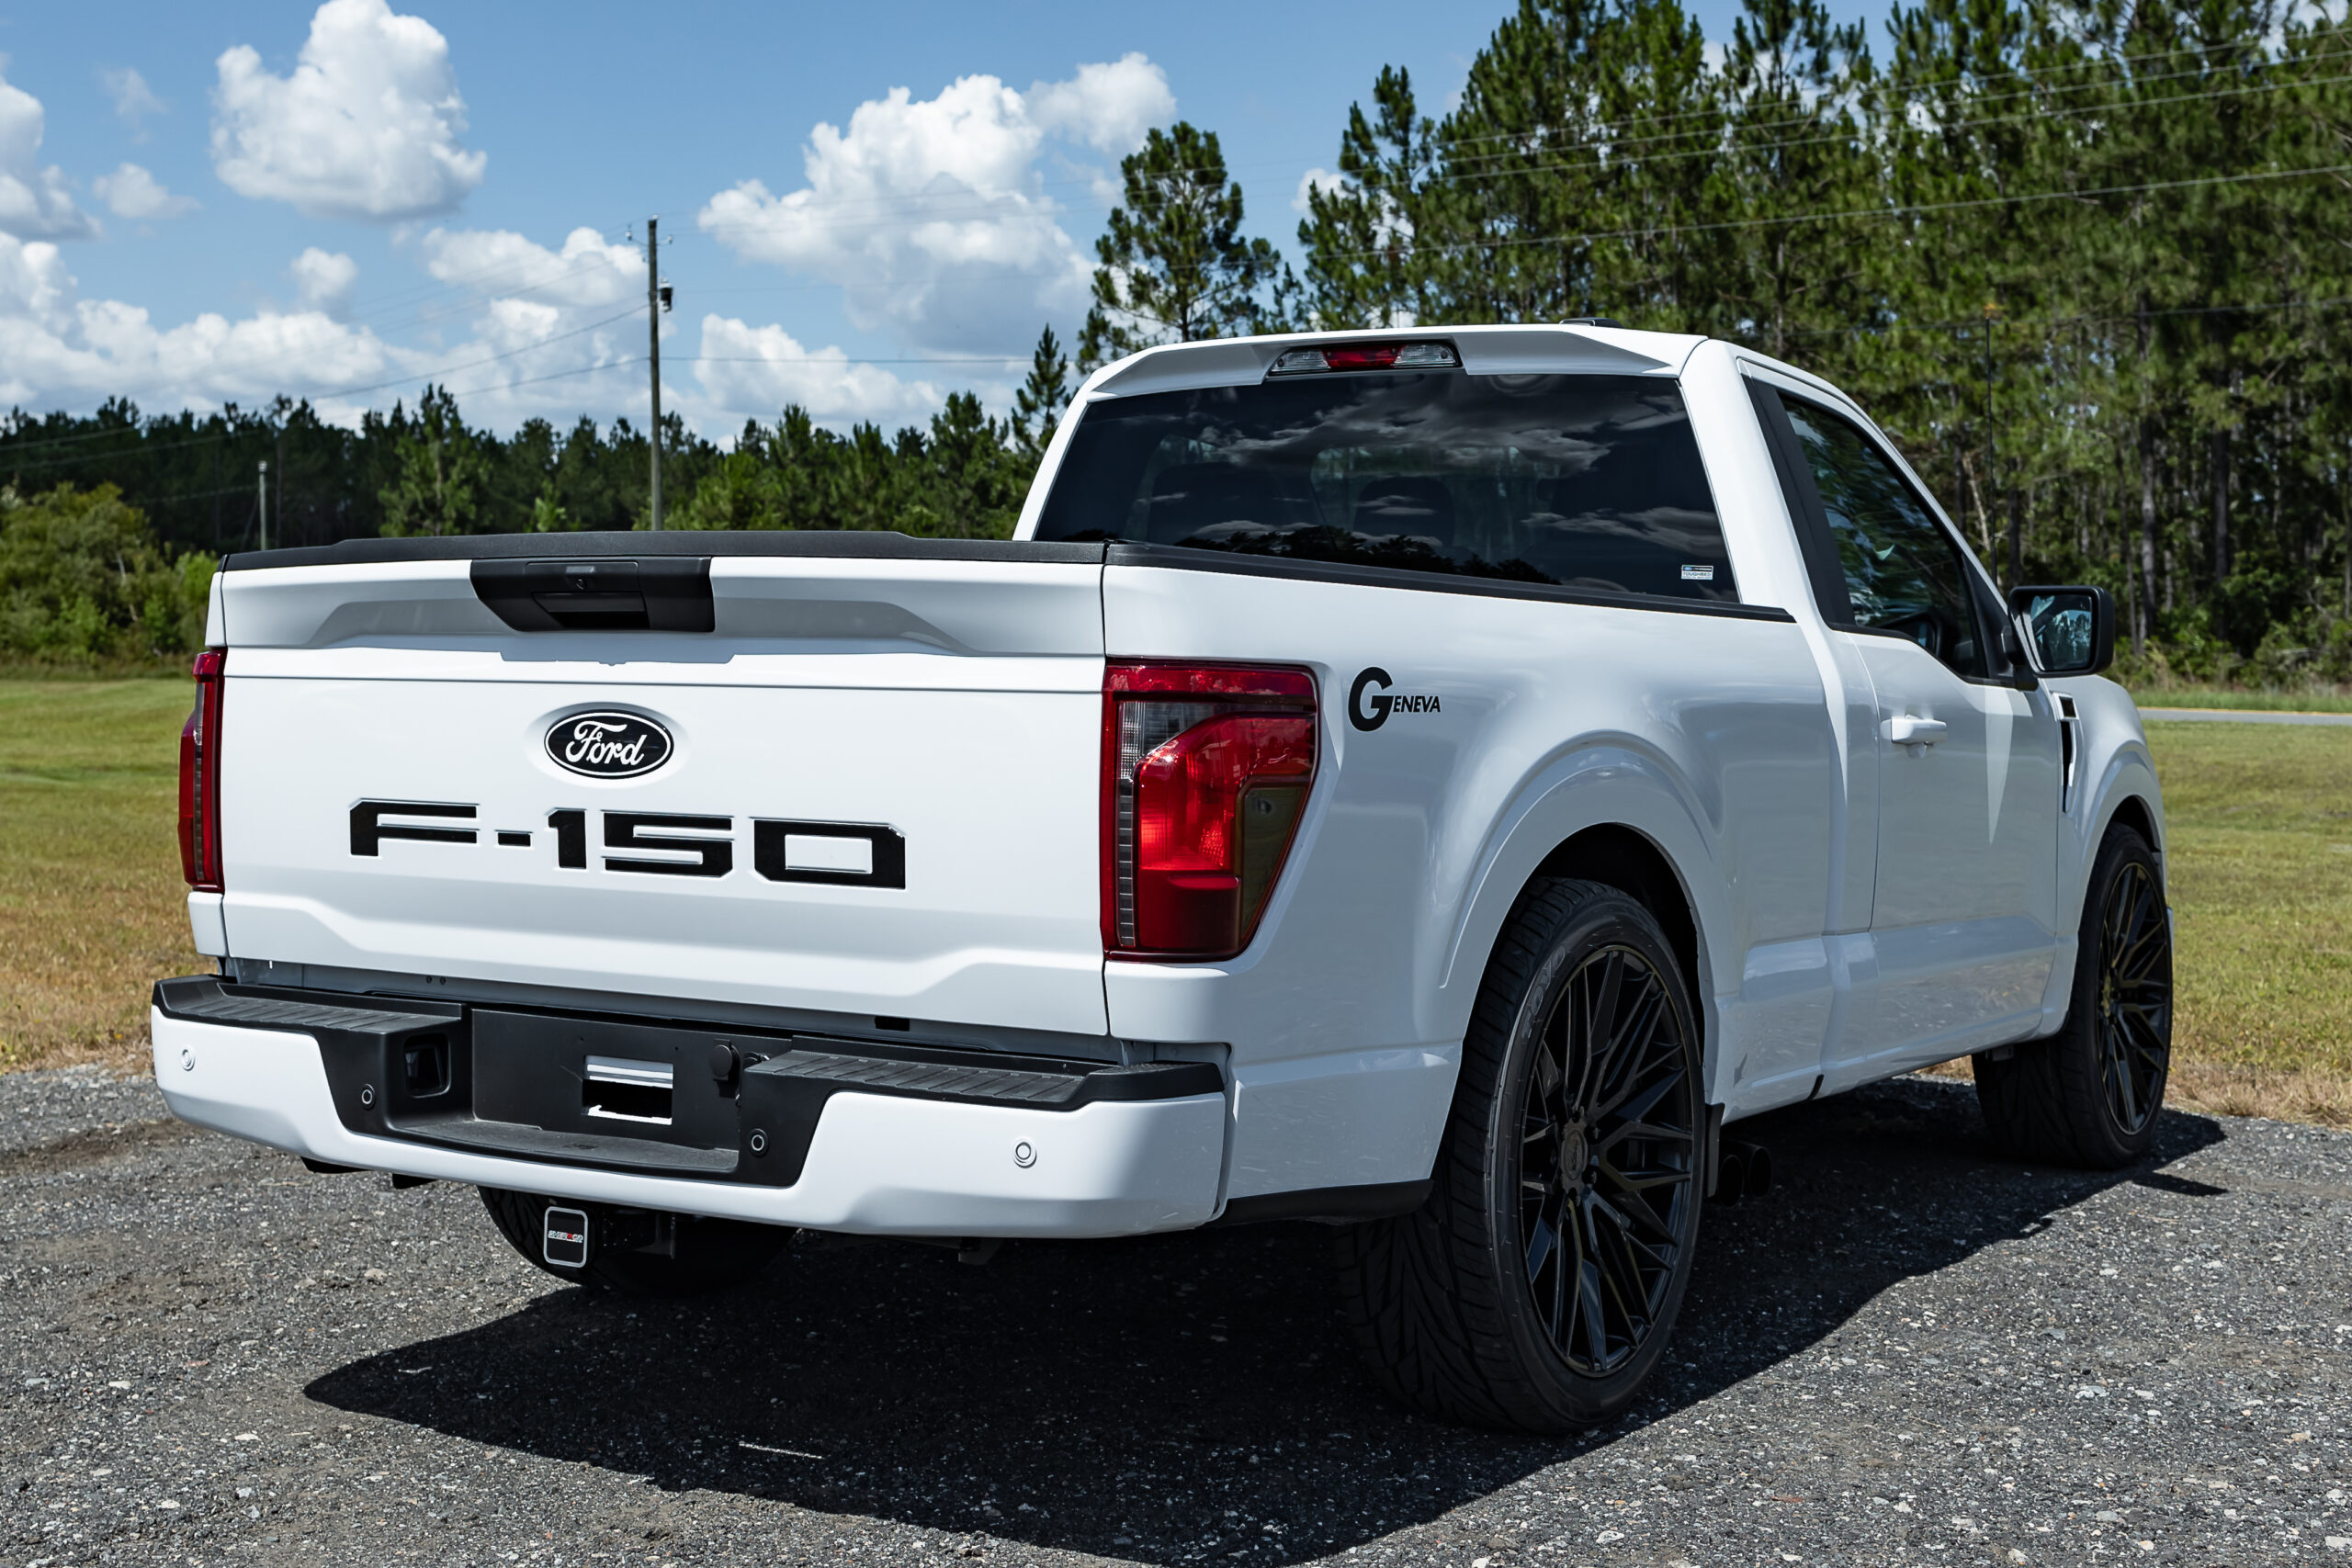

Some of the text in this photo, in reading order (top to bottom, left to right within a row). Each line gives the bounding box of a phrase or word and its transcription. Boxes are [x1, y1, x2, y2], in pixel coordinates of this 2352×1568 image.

[1348, 666, 1442, 732] GENEVA
[565, 720, 648, 766] Ford
[349, 797, 907, 890] F-150
[1520, 944, 1566, 1040] TOYO
